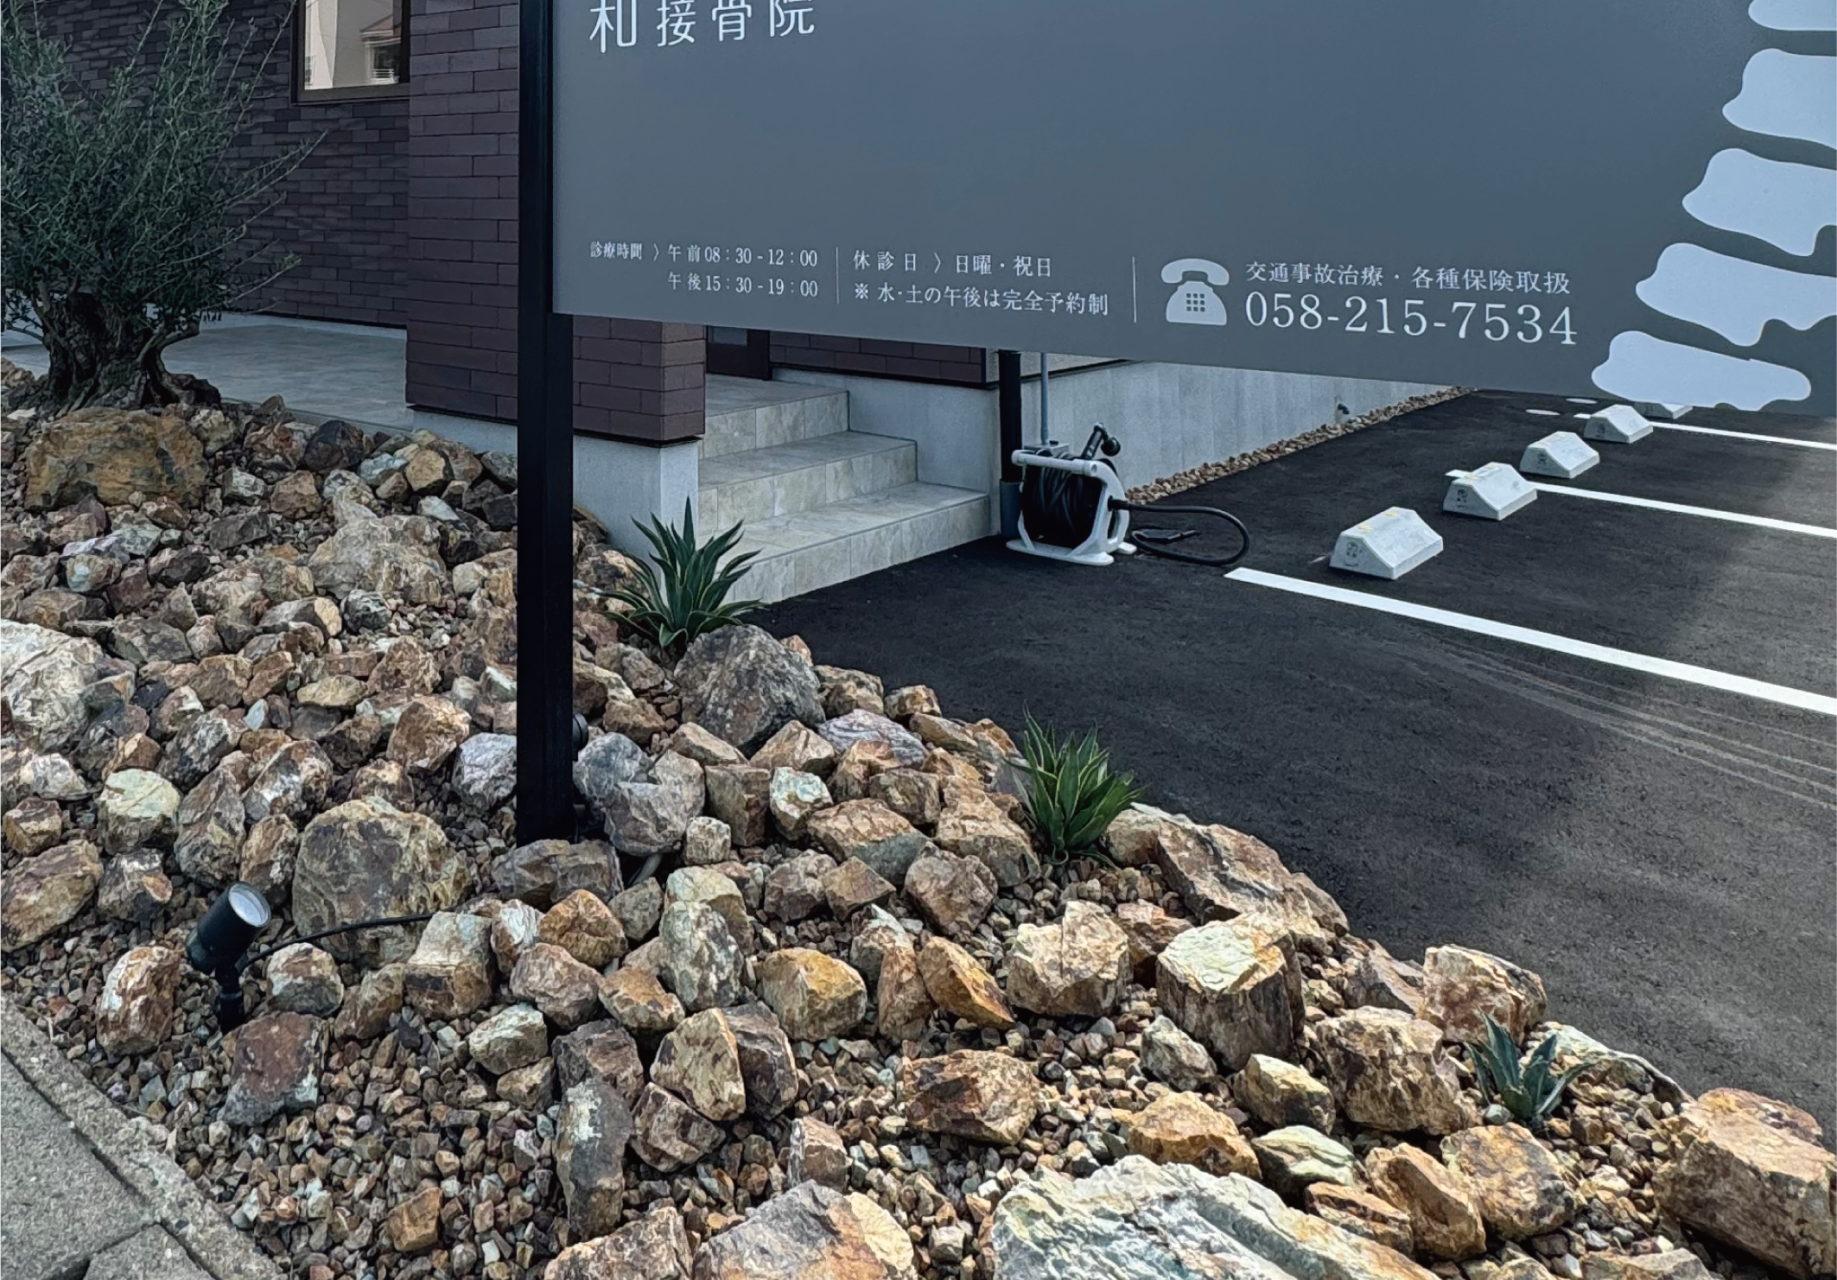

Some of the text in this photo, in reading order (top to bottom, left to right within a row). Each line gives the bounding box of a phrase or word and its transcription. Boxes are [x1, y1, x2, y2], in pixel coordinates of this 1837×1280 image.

[590, 240, 642, 261] 診療時間
[1245, 291, 1578, 346] 058-215-7534
